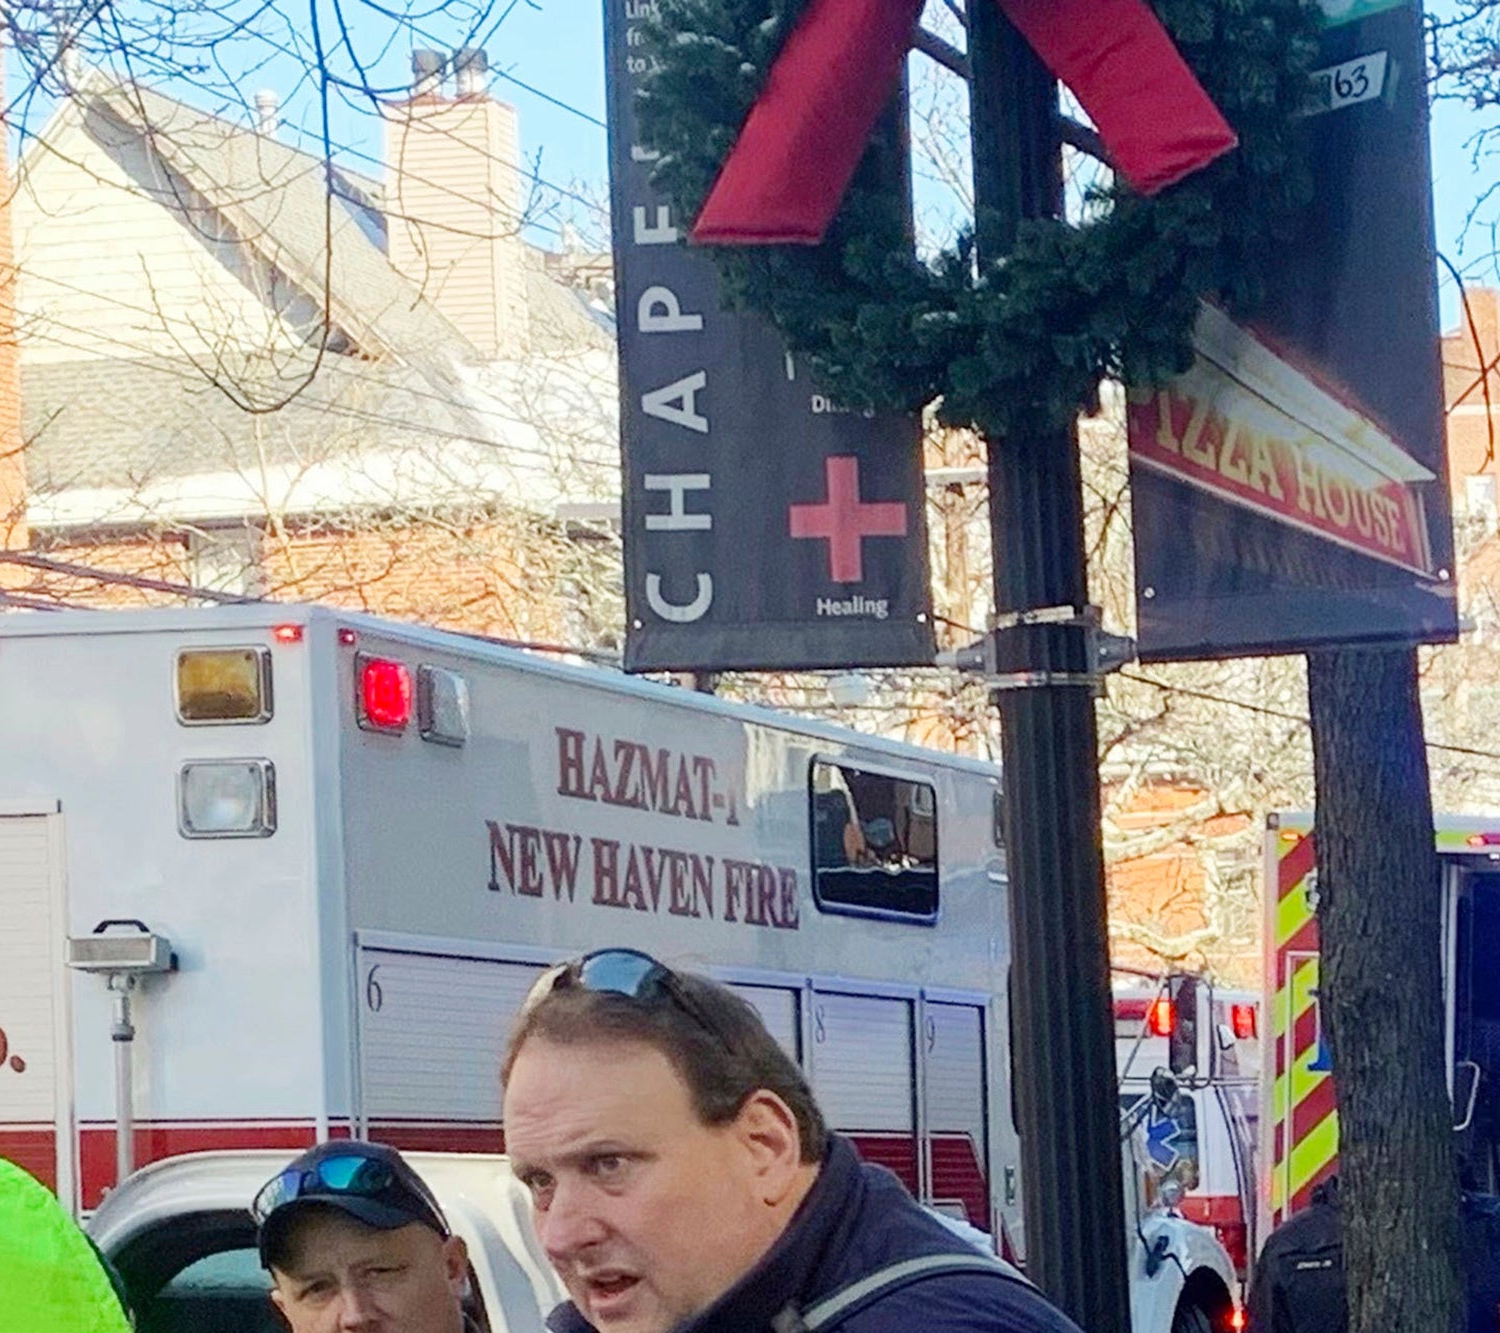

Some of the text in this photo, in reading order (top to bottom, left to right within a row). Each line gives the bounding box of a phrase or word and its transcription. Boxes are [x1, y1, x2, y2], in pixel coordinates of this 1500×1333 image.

[1133, 392, 1407, 554] IZZA HOUSE
[816, 597, 889, 618] Healing
[486, 821, 799, 930] NEW HAVEN FIRE
[365, 965, 938, 1053] 6 8 9
